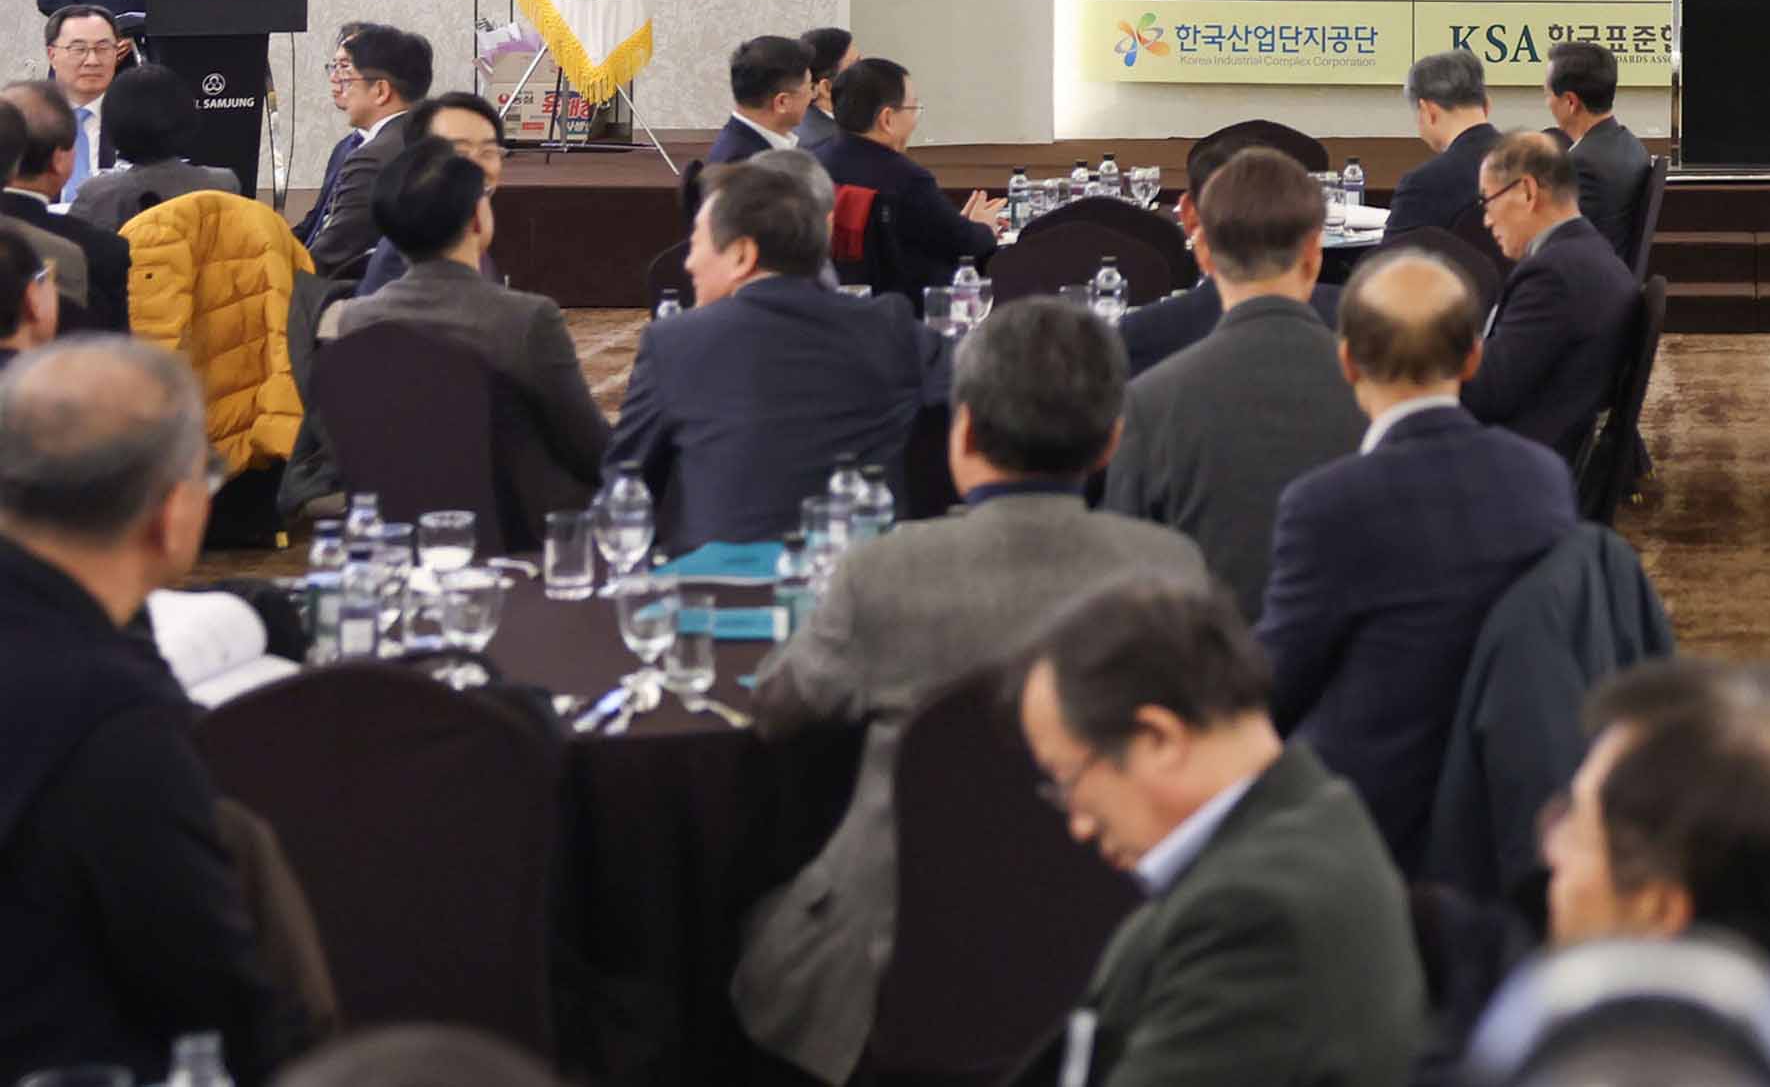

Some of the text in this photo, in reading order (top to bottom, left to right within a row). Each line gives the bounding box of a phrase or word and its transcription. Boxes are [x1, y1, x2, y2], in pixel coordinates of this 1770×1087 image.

[1175, 24, 1379, 54] 한국산업단지공단
[1449, 24, 1542, 63] KSA
[204, 97, 255, 109] SAMJUNG
